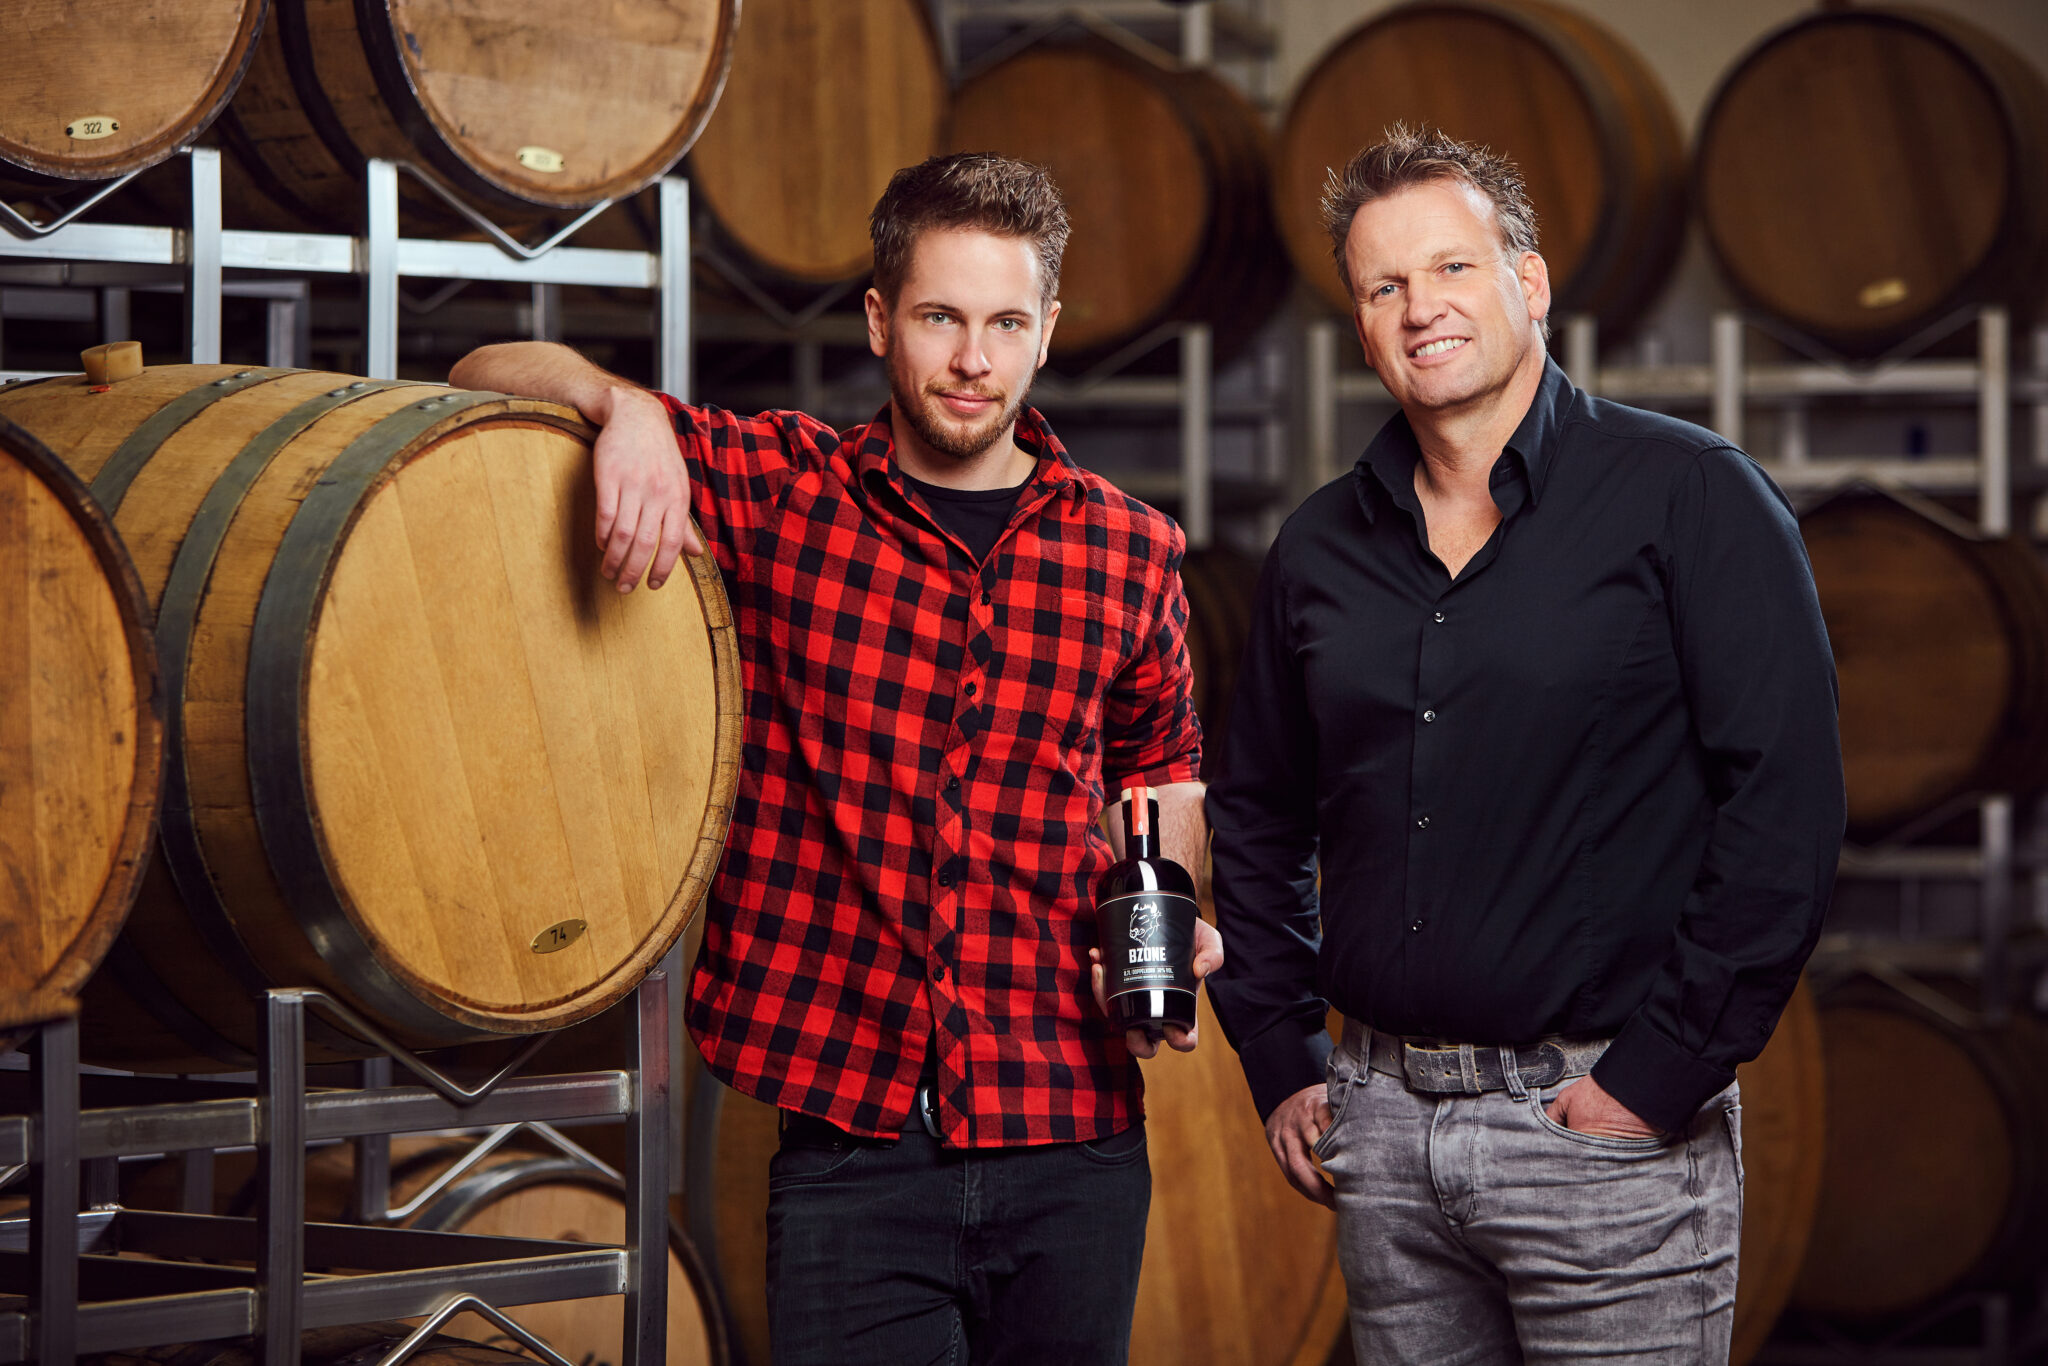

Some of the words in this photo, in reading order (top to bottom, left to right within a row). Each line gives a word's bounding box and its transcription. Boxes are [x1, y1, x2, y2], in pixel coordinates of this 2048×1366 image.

[83, 121, 102, 135] 322
[550, 926, 567, 944] 74
[1128, 946, 1167, 964] BZONE
